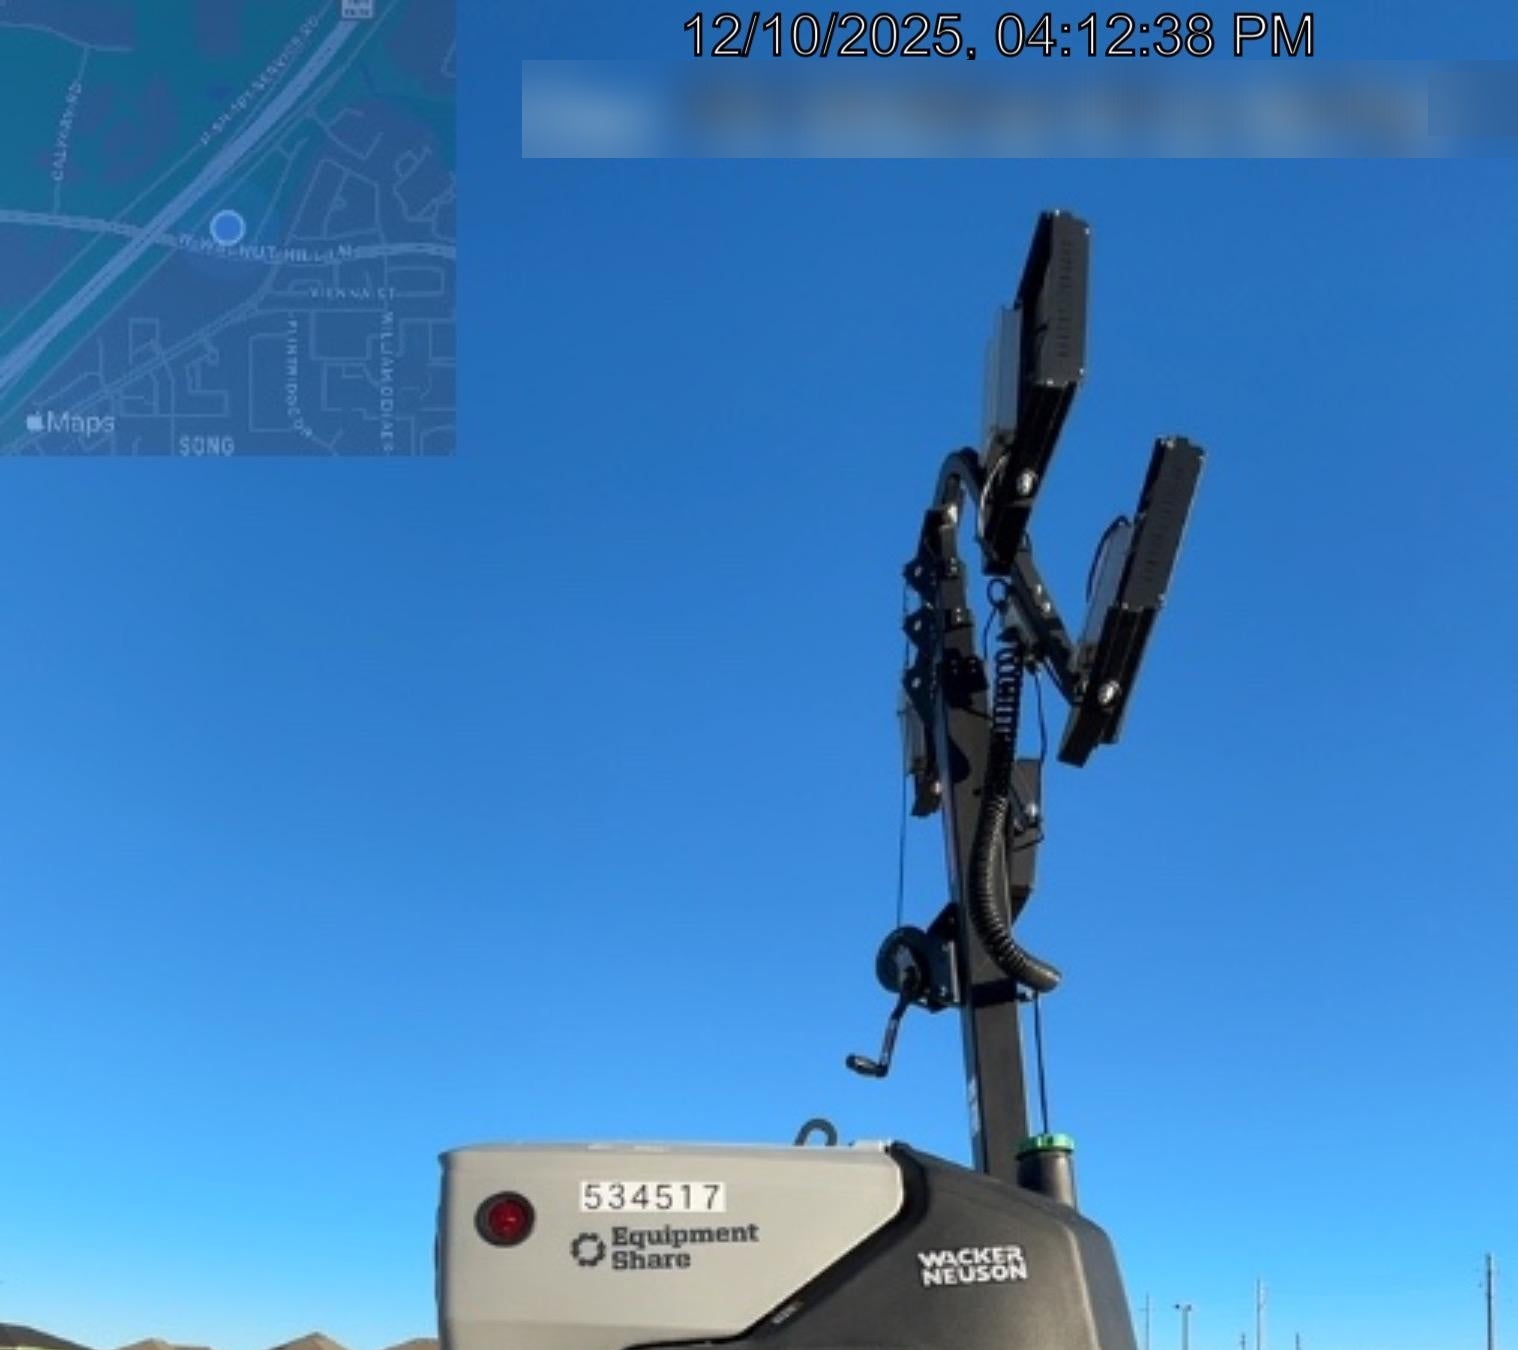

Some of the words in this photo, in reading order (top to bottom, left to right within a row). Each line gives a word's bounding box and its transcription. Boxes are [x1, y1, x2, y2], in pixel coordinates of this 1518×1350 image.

[584, 1183, 721, 1210] 534517
[612, 1224, 759, 1249] Equipment
[612, 1251, 691, 1270] Share
[917, 1245, 1026, 1267] WACKER
[922, 1261, 1028, 1286] NEUSON
